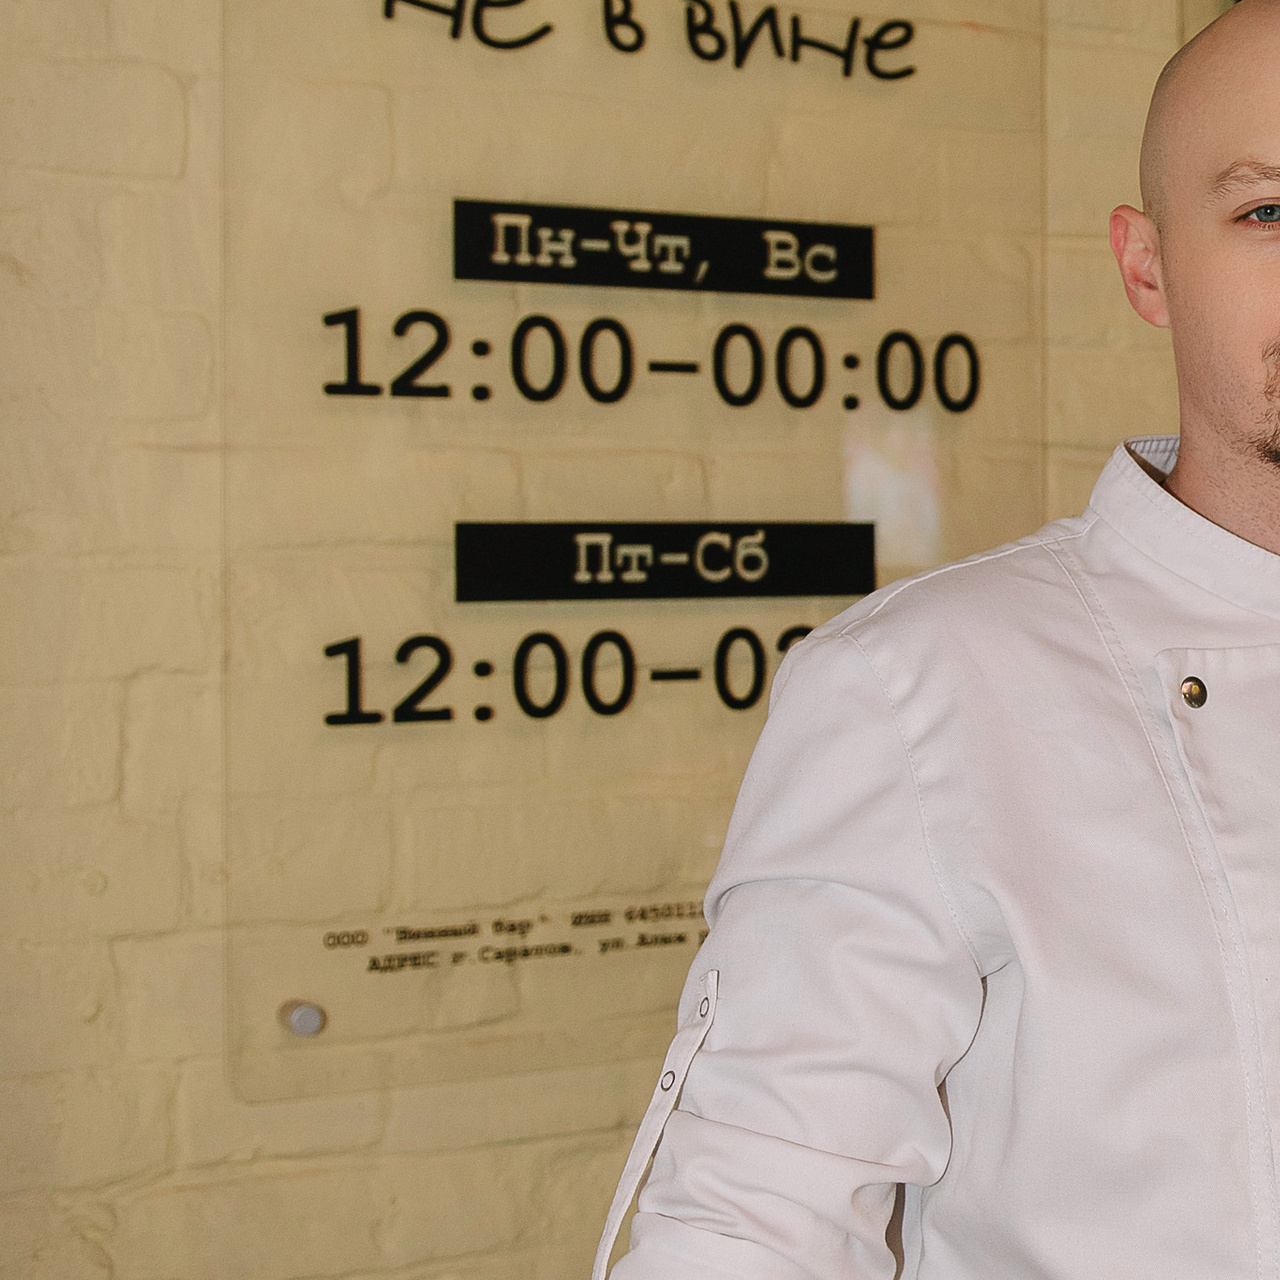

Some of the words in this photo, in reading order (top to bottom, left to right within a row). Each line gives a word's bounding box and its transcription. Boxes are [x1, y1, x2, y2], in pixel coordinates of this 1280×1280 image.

[489, 213, 712, 285] Пн-Чт,
[763, 230, 838, 282] Вс
[323, 307, 981, 414] 12:00-00:00
[573, 530, 769, 584] Пт-Сб
[324, 624, 814, 726] 12:00-0
